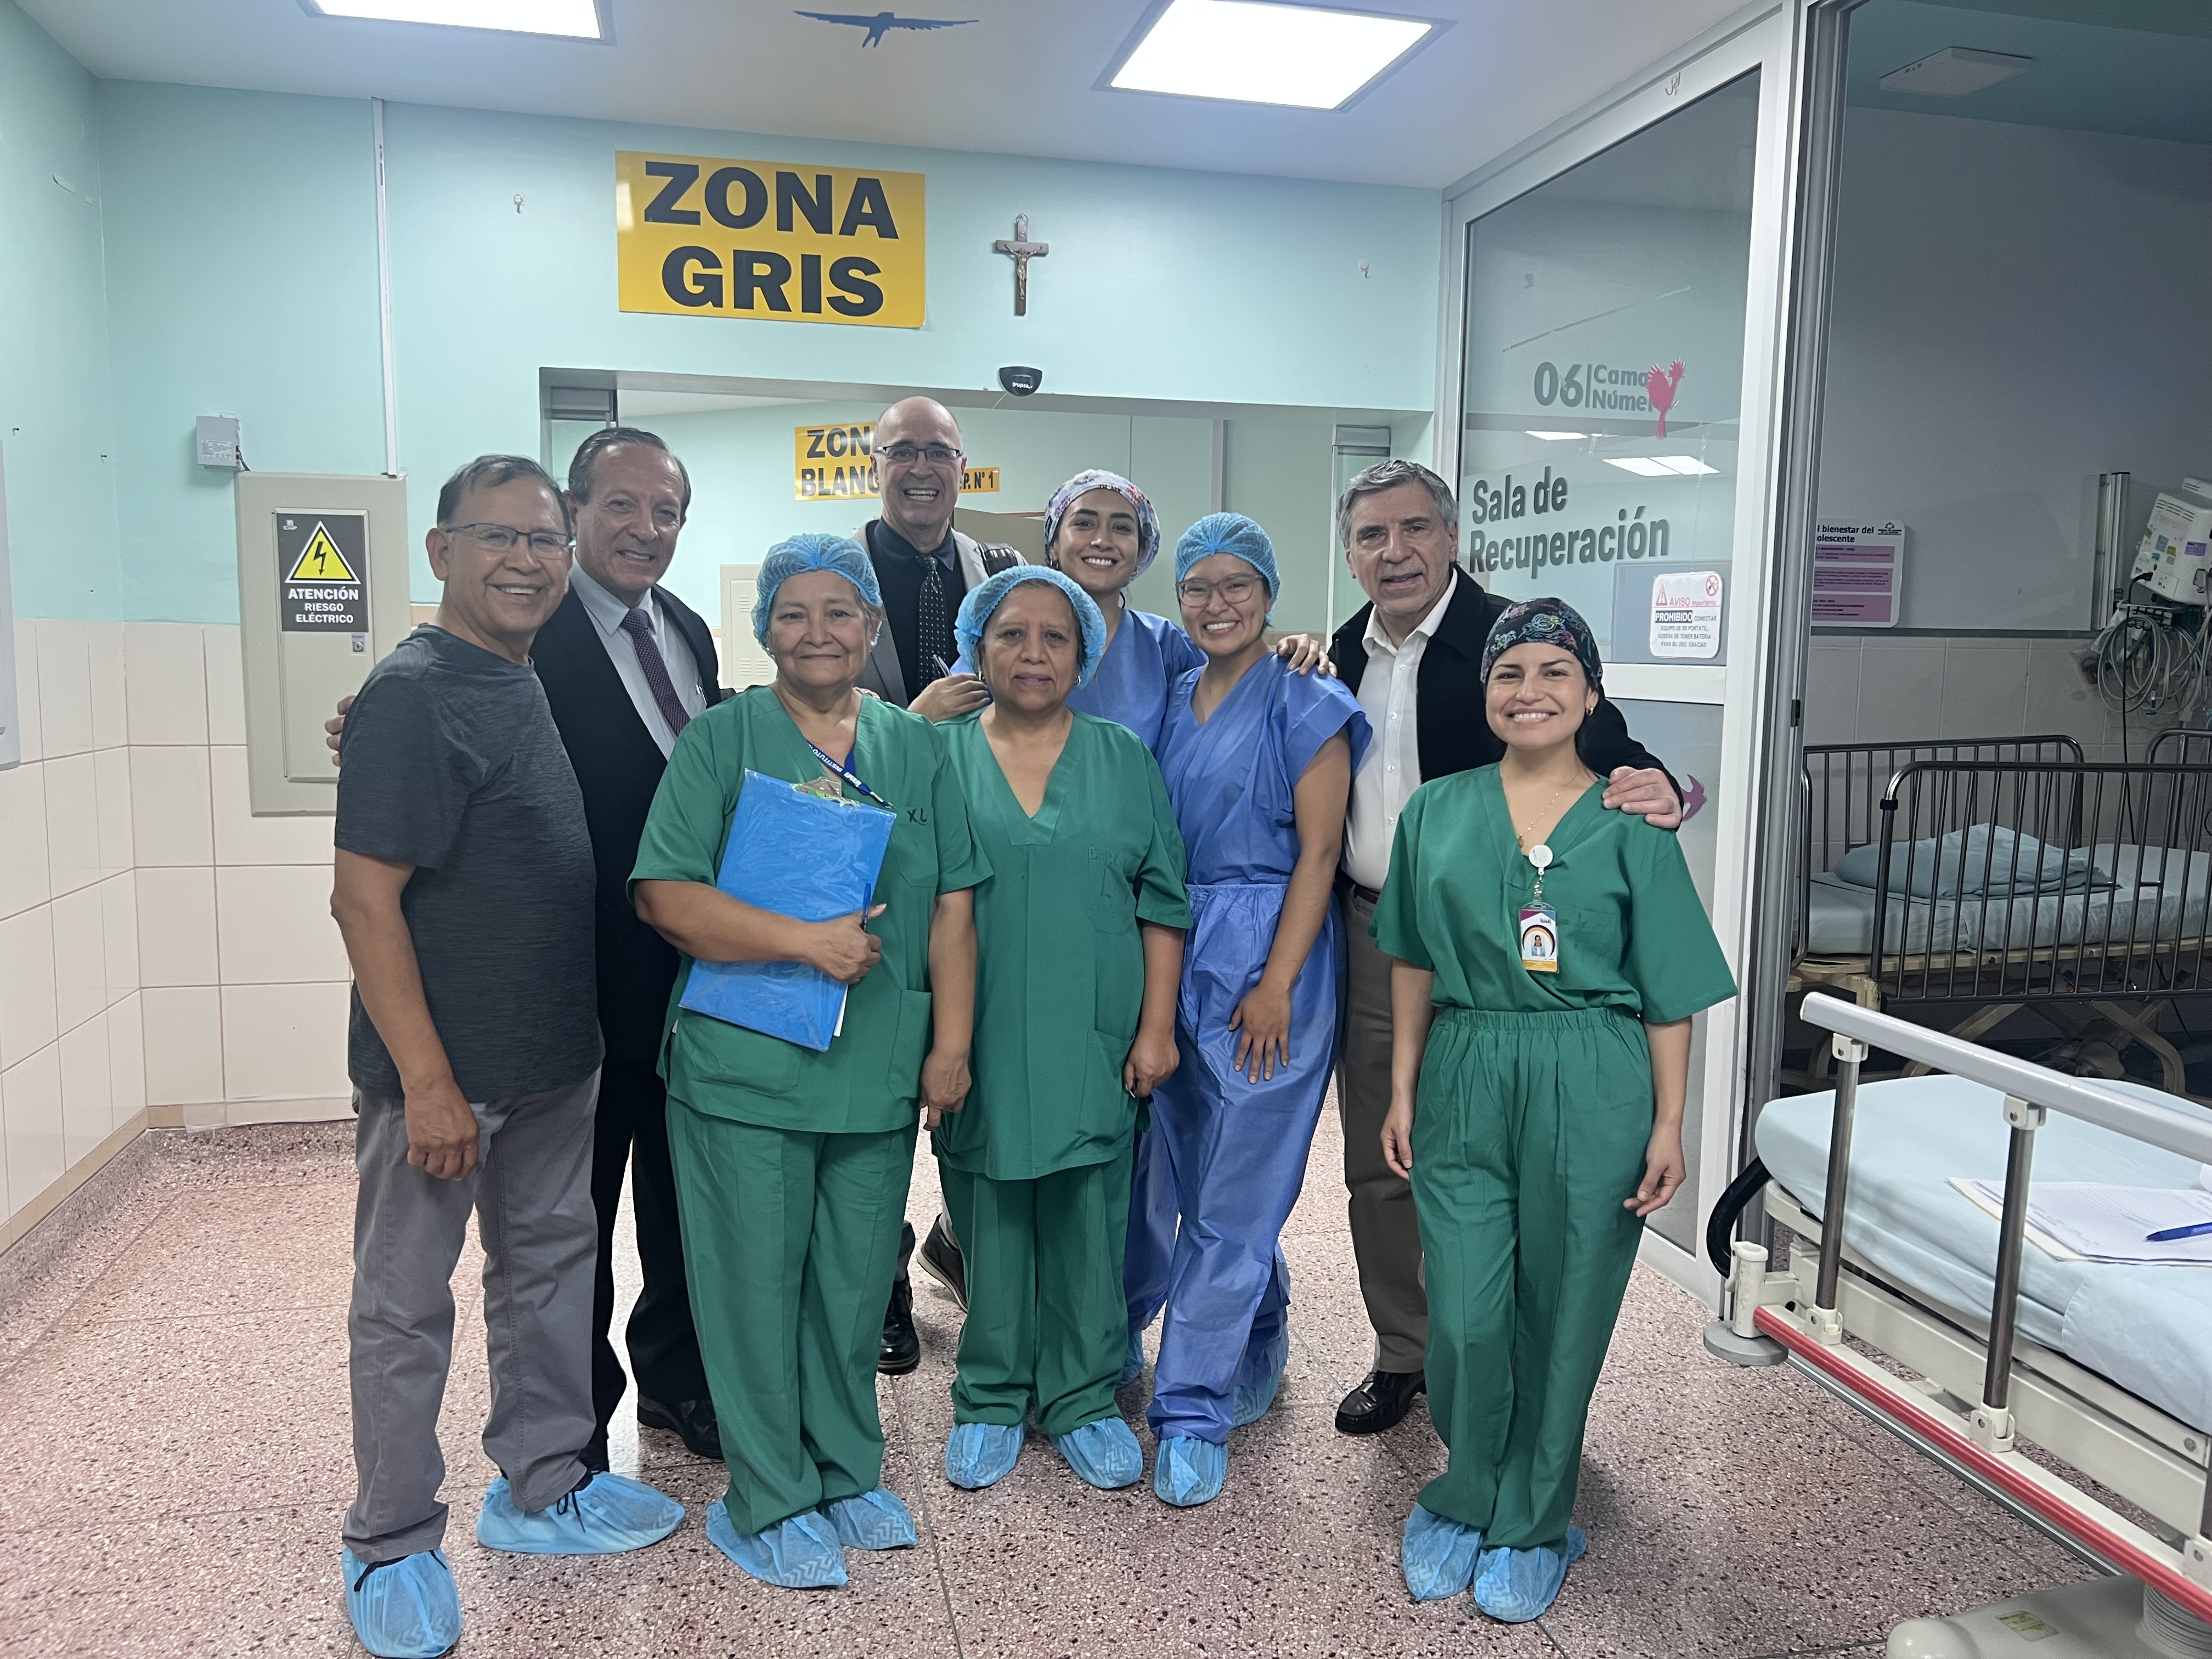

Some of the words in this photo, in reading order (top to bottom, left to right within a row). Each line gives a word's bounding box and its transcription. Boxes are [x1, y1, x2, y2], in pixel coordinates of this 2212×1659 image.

[644, 160, 899, 240] ZONA
[662, 245, 884, 317] GRIS
[1534, 362, 1584, 408] 06
[1594, 364, 1648, 387] Cama
[1592, 389, 1653, 413] Núme
[806, 426, 871, 459] ZON
[801, 465, 881, 496] BLANC
[989, 471, 994, 488] 1
[1472, 474, 1526, 524] Sala
[1533, 466, 1567, 515] de
[1817, 534, 1855, 543] olescente
[1822, 524, 1860, 533] bienestar
[1469, 505, 1669, 579] Recuperación
[288, 586, 359, 600] ATENCIÓN
[1669, 597, 1690, 606] AVISO
[304, 602, 345, 612] RIESGO
[1655, 612, 1692, 622] PROHIBIDO
[296, 612, 354, 623] ELÉCTRICO
[812, 748, 843, 772] INSTITUTO
[907, 808, 928, 823] XL
